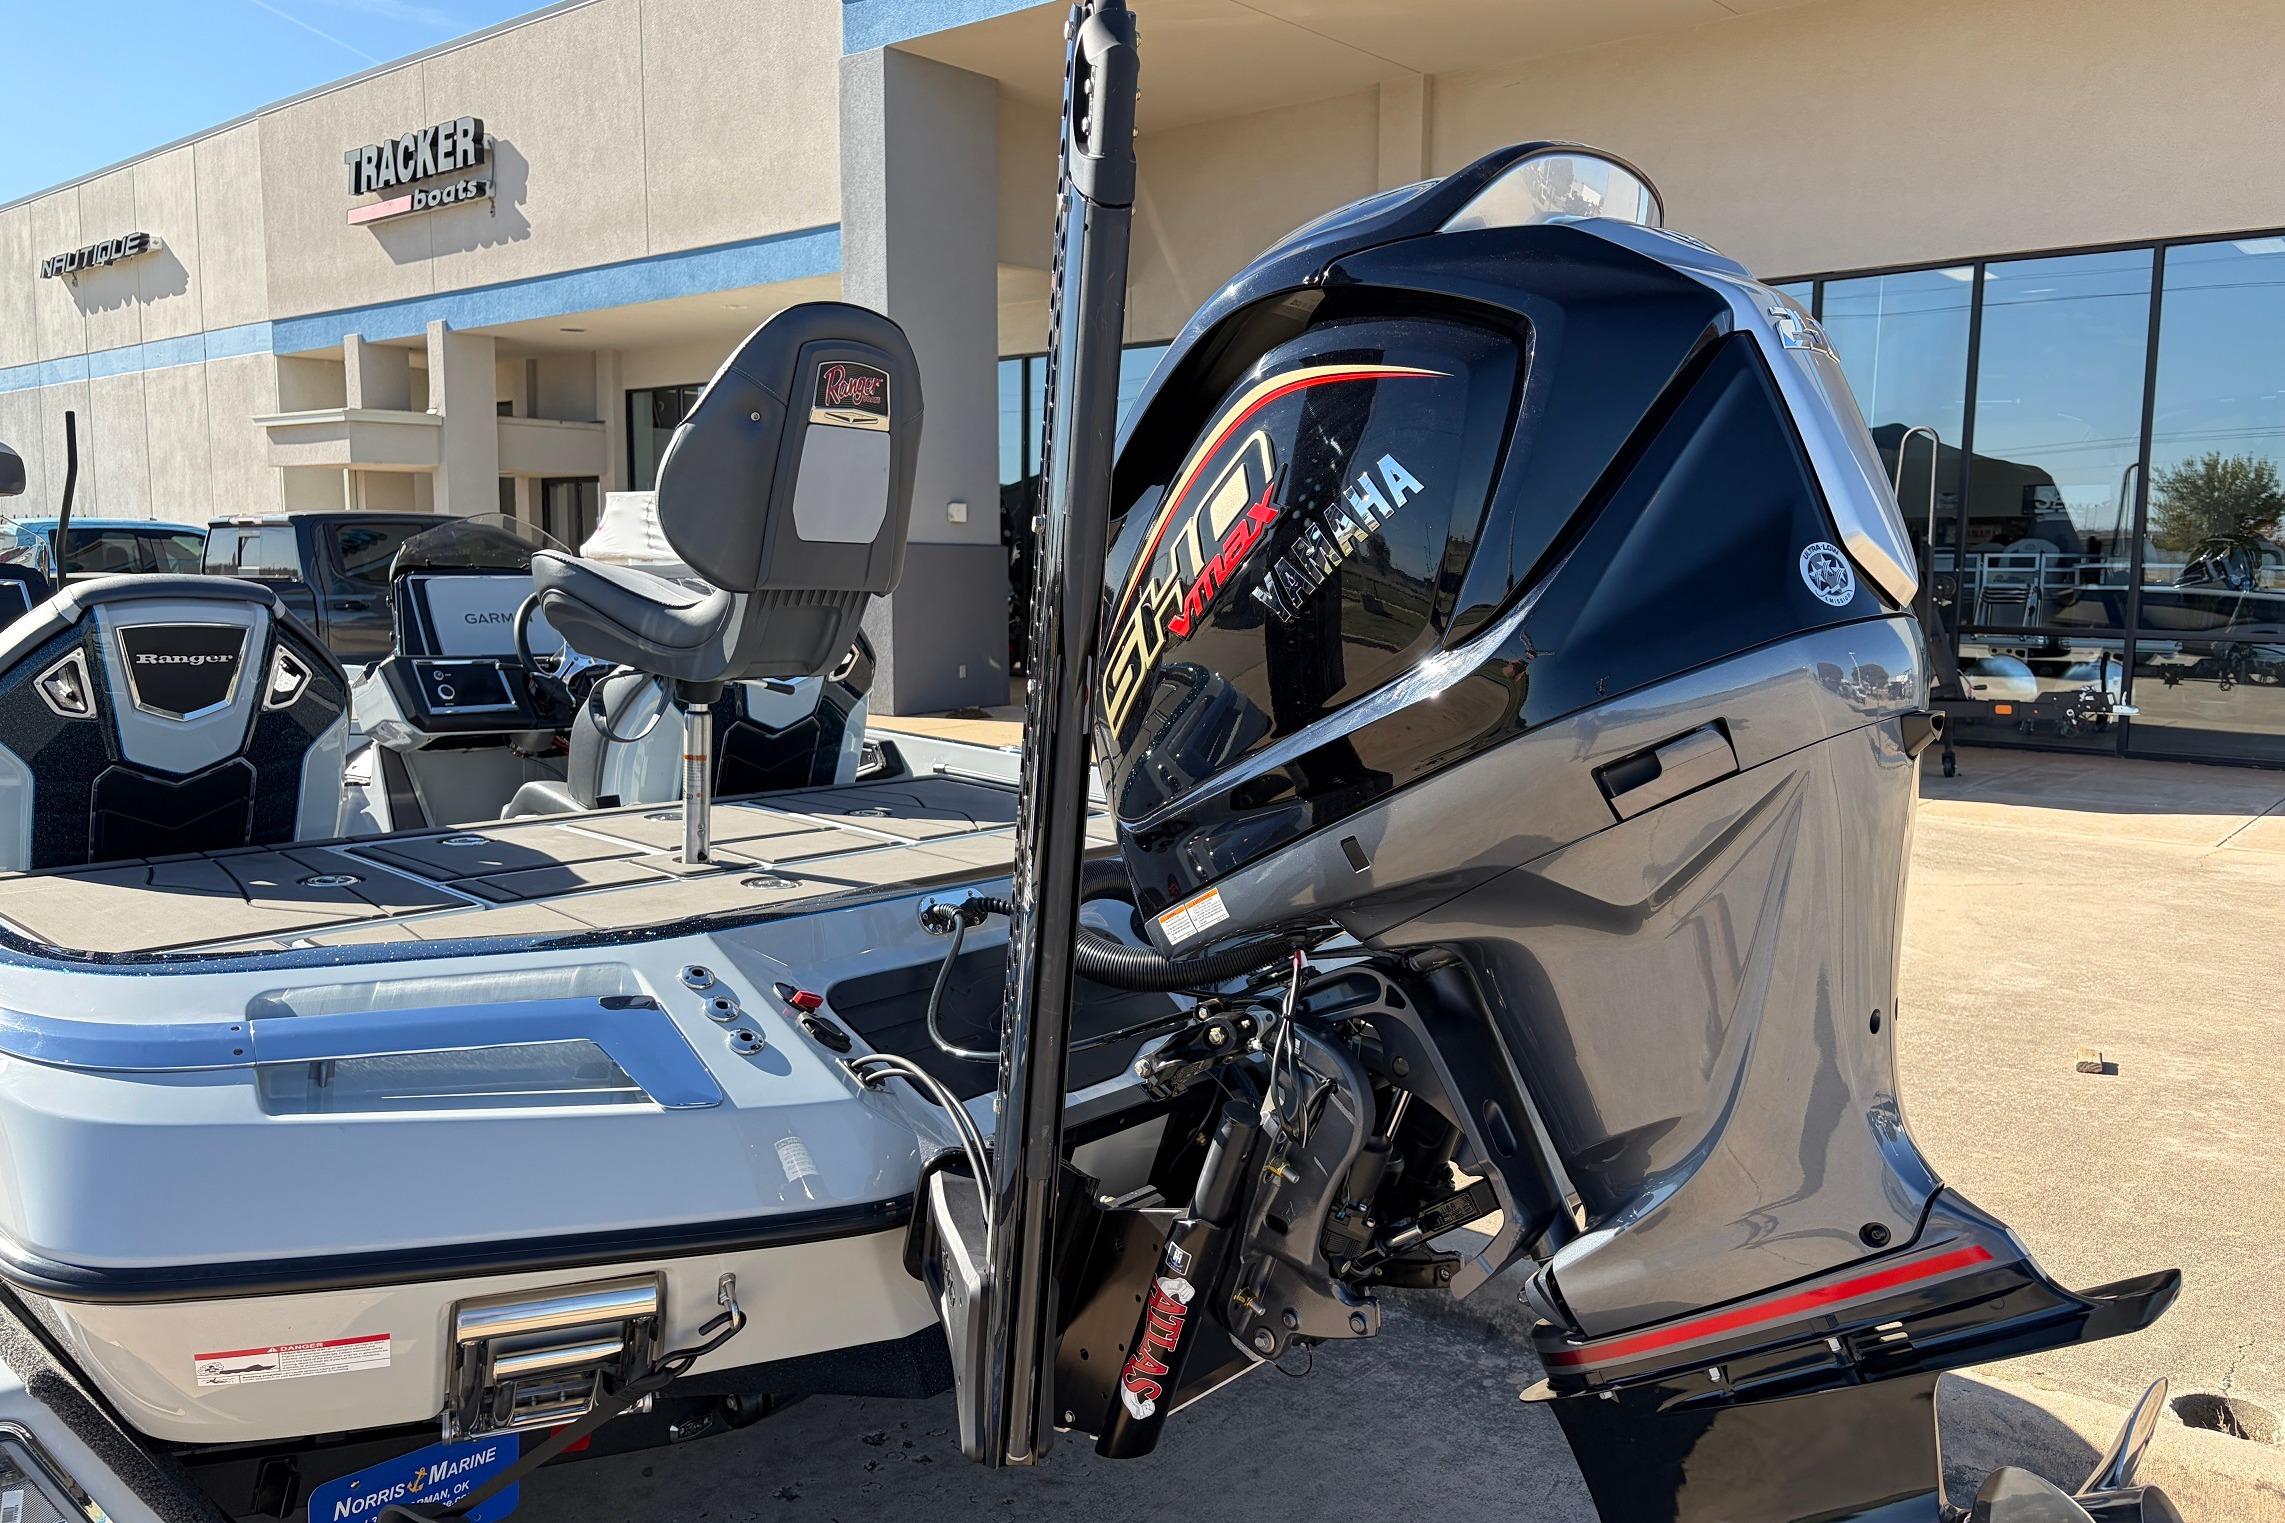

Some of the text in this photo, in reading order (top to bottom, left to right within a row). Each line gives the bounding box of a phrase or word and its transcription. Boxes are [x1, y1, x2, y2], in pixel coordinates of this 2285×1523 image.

[344, 115, 480, 195] TRACKER
[412, 179, 478, 210] boats
[40, 231, 145, 279] NAUTIQUE
[823, 364, 884, 406] Ranger
[1251, 453, 1425, 623] YAMAHA
[464, 612, 533, 625] GARMN
[136, 653, 234, 666] Ranger
[280, 1342, 324, 1352] DANGER
[1121, 1273, 1188, 1401] ATLAS
[333, 1447, 497, 1521] NORRIS MARINE
[453, 1480, 470, 1494] OK
